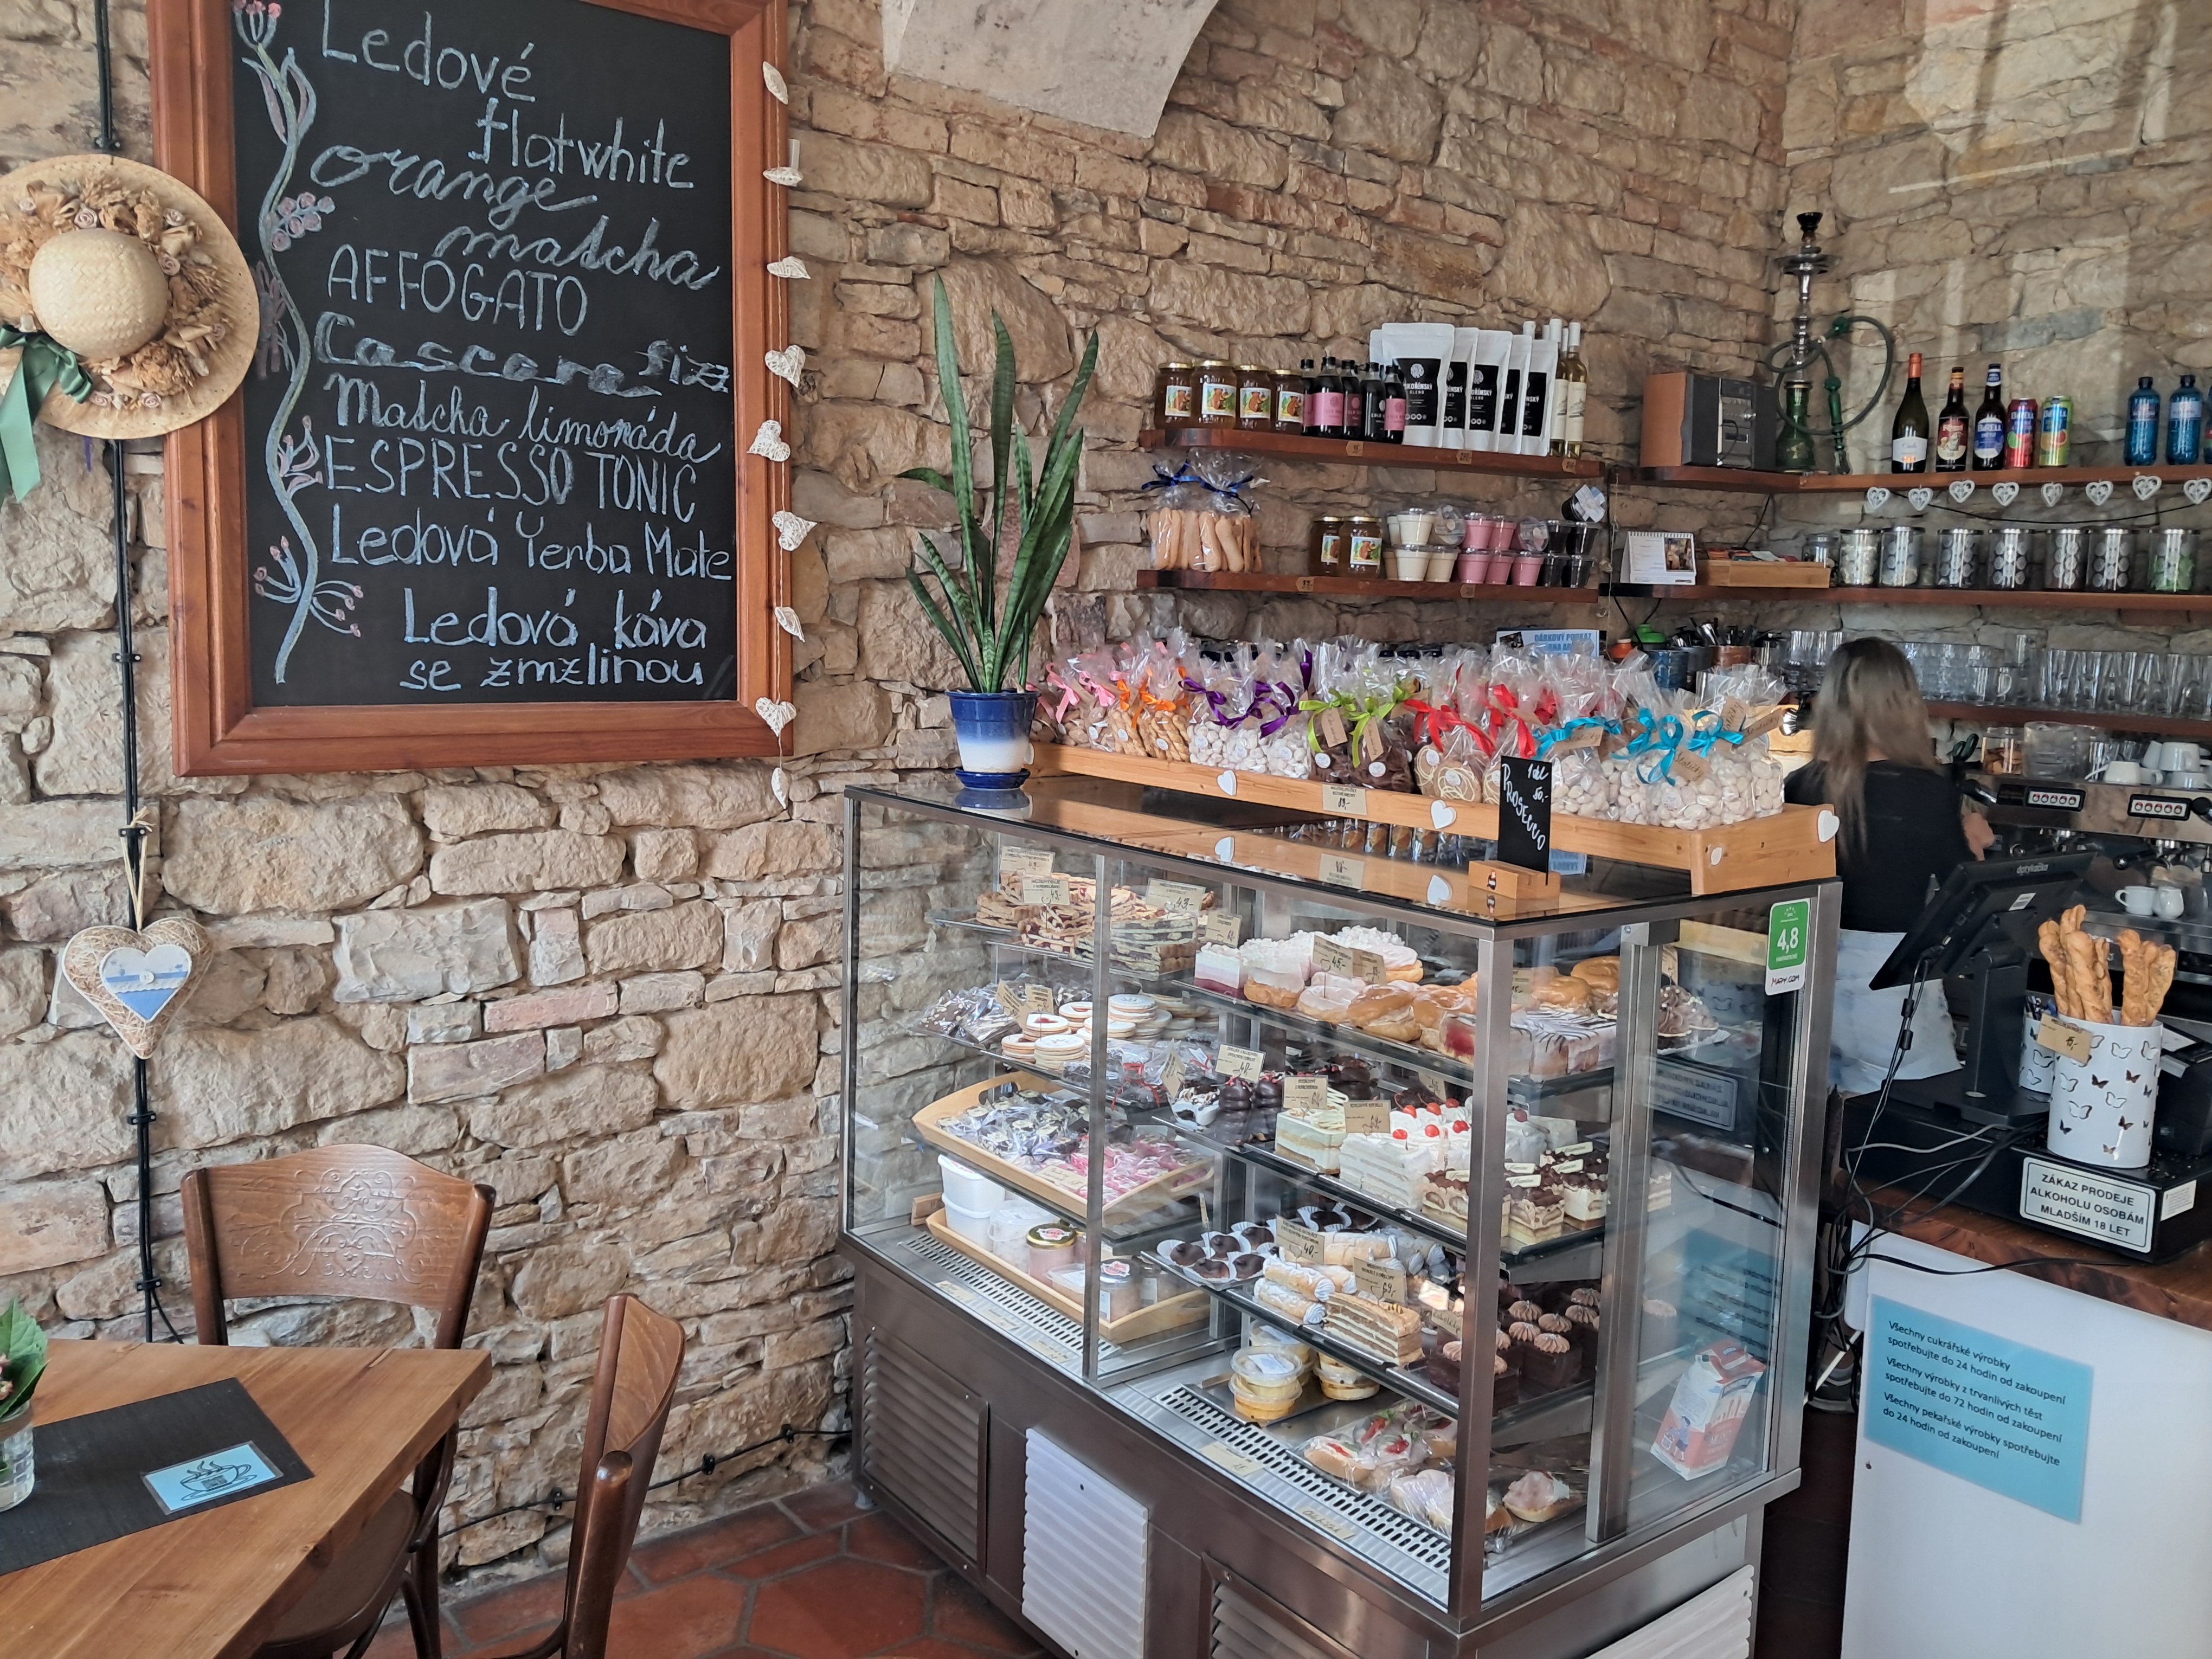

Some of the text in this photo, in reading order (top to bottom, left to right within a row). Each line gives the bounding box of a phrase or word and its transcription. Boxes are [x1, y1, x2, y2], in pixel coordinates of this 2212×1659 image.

[322, 0, 536, 103] Ledové
[310, 144, 599, 231] orange
[433, 215, 721, 291] matcha
[327, 243, 588, 336] AFFOGATO
[324, 372, 722, 465] Matcha limonáda
[326, 434, 697, 524] ESPRESSO TONIC
[332, 503, 732, 581] Ledová Yerba Mate
[403, 586, 707, 650] Ledová káva
[398, 657, 462, 691] se
[1175, 896, 1194, 910] 43,-
[1332, 956, 1346, 970] 45,-
[1777, 927, 1799, 954] 4,8
[2030, 1187, 2144, 1225] ALKOHOLU OSOBÁM
[2041, 1174, 2134, 1206] ZÁKAZ PRODEJE
[2041, 1205, 2131, 1237] MLADŠÍM 18 LET
[1304, 1243, 1319, 1258] 40,-
[1888, 1336, 2066, 1405] spotřebujte do 24 hodin od zakoupení
[1889, 1321, 2011, 1372] Všechny cukrářské výrobky
[1886, 1373, 2062, 1443] spotřebujte do 72 hodin od zakoupení
[1887, 1356, 1922, 1378] Všechny
[1924, 1372, 1960, 1392] výrobky
[1969, 1387, 2021, 1413] trvanlivých
[2024, 1407, 2043, 1420] těst
[1883, 1407, 1999, 1459] do 24 hodin od zakoupení
[1884, 1392, 2060, 1466] Všechny pekařské výrobky spotřebujte
